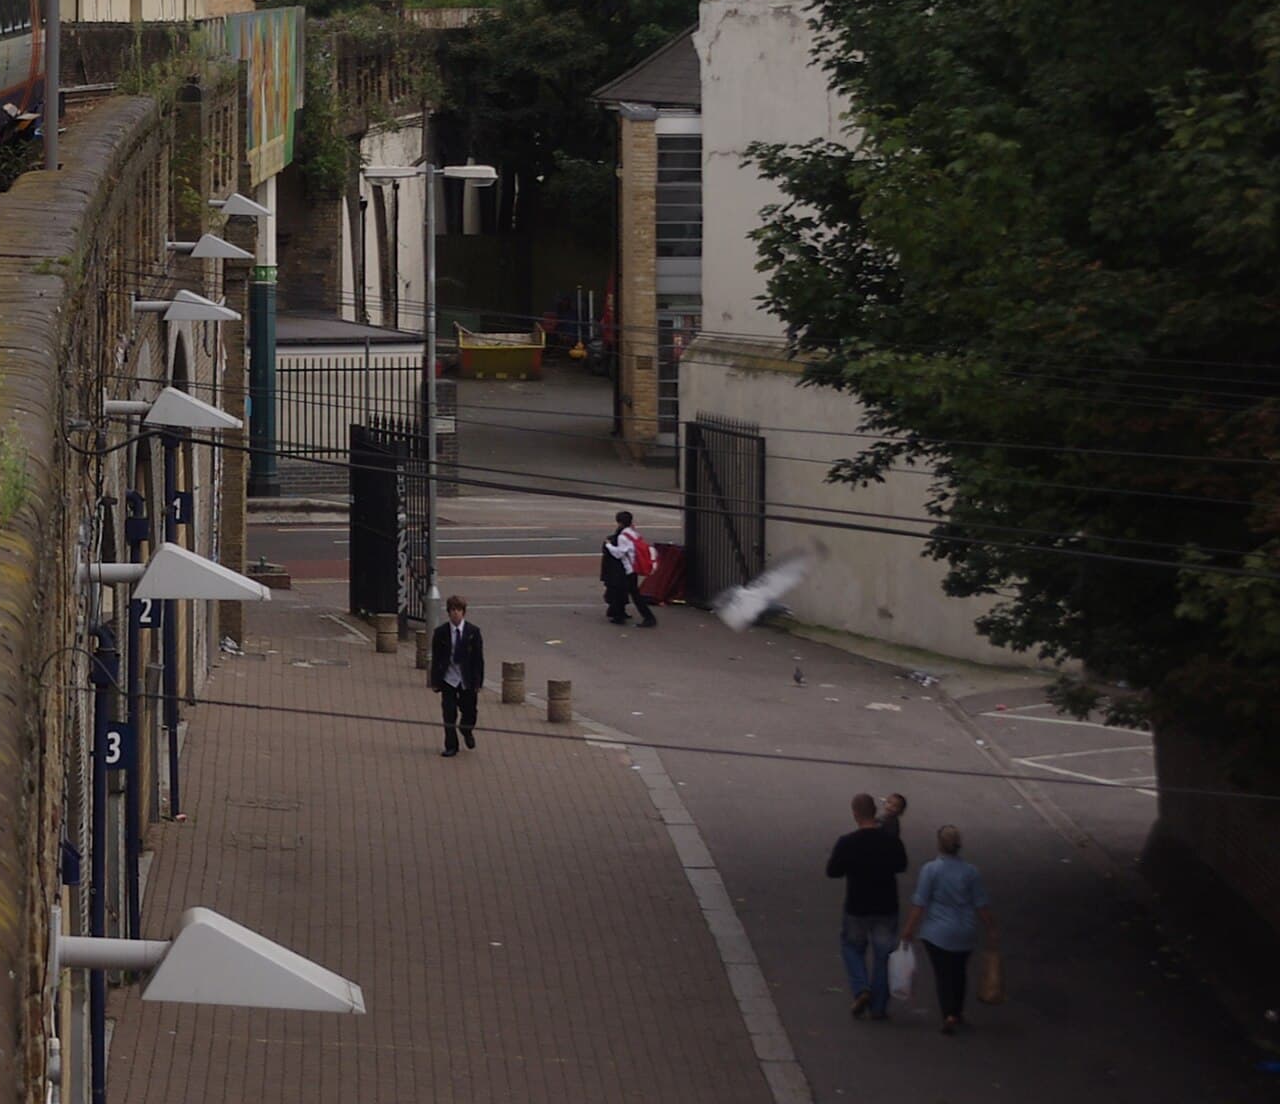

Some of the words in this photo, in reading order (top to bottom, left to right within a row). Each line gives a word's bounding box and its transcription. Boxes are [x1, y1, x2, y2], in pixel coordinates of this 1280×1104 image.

[172, 497, 182, 520] 1
[140, 598, 153, 624] 2
[105, 731, 121, 765] 3
